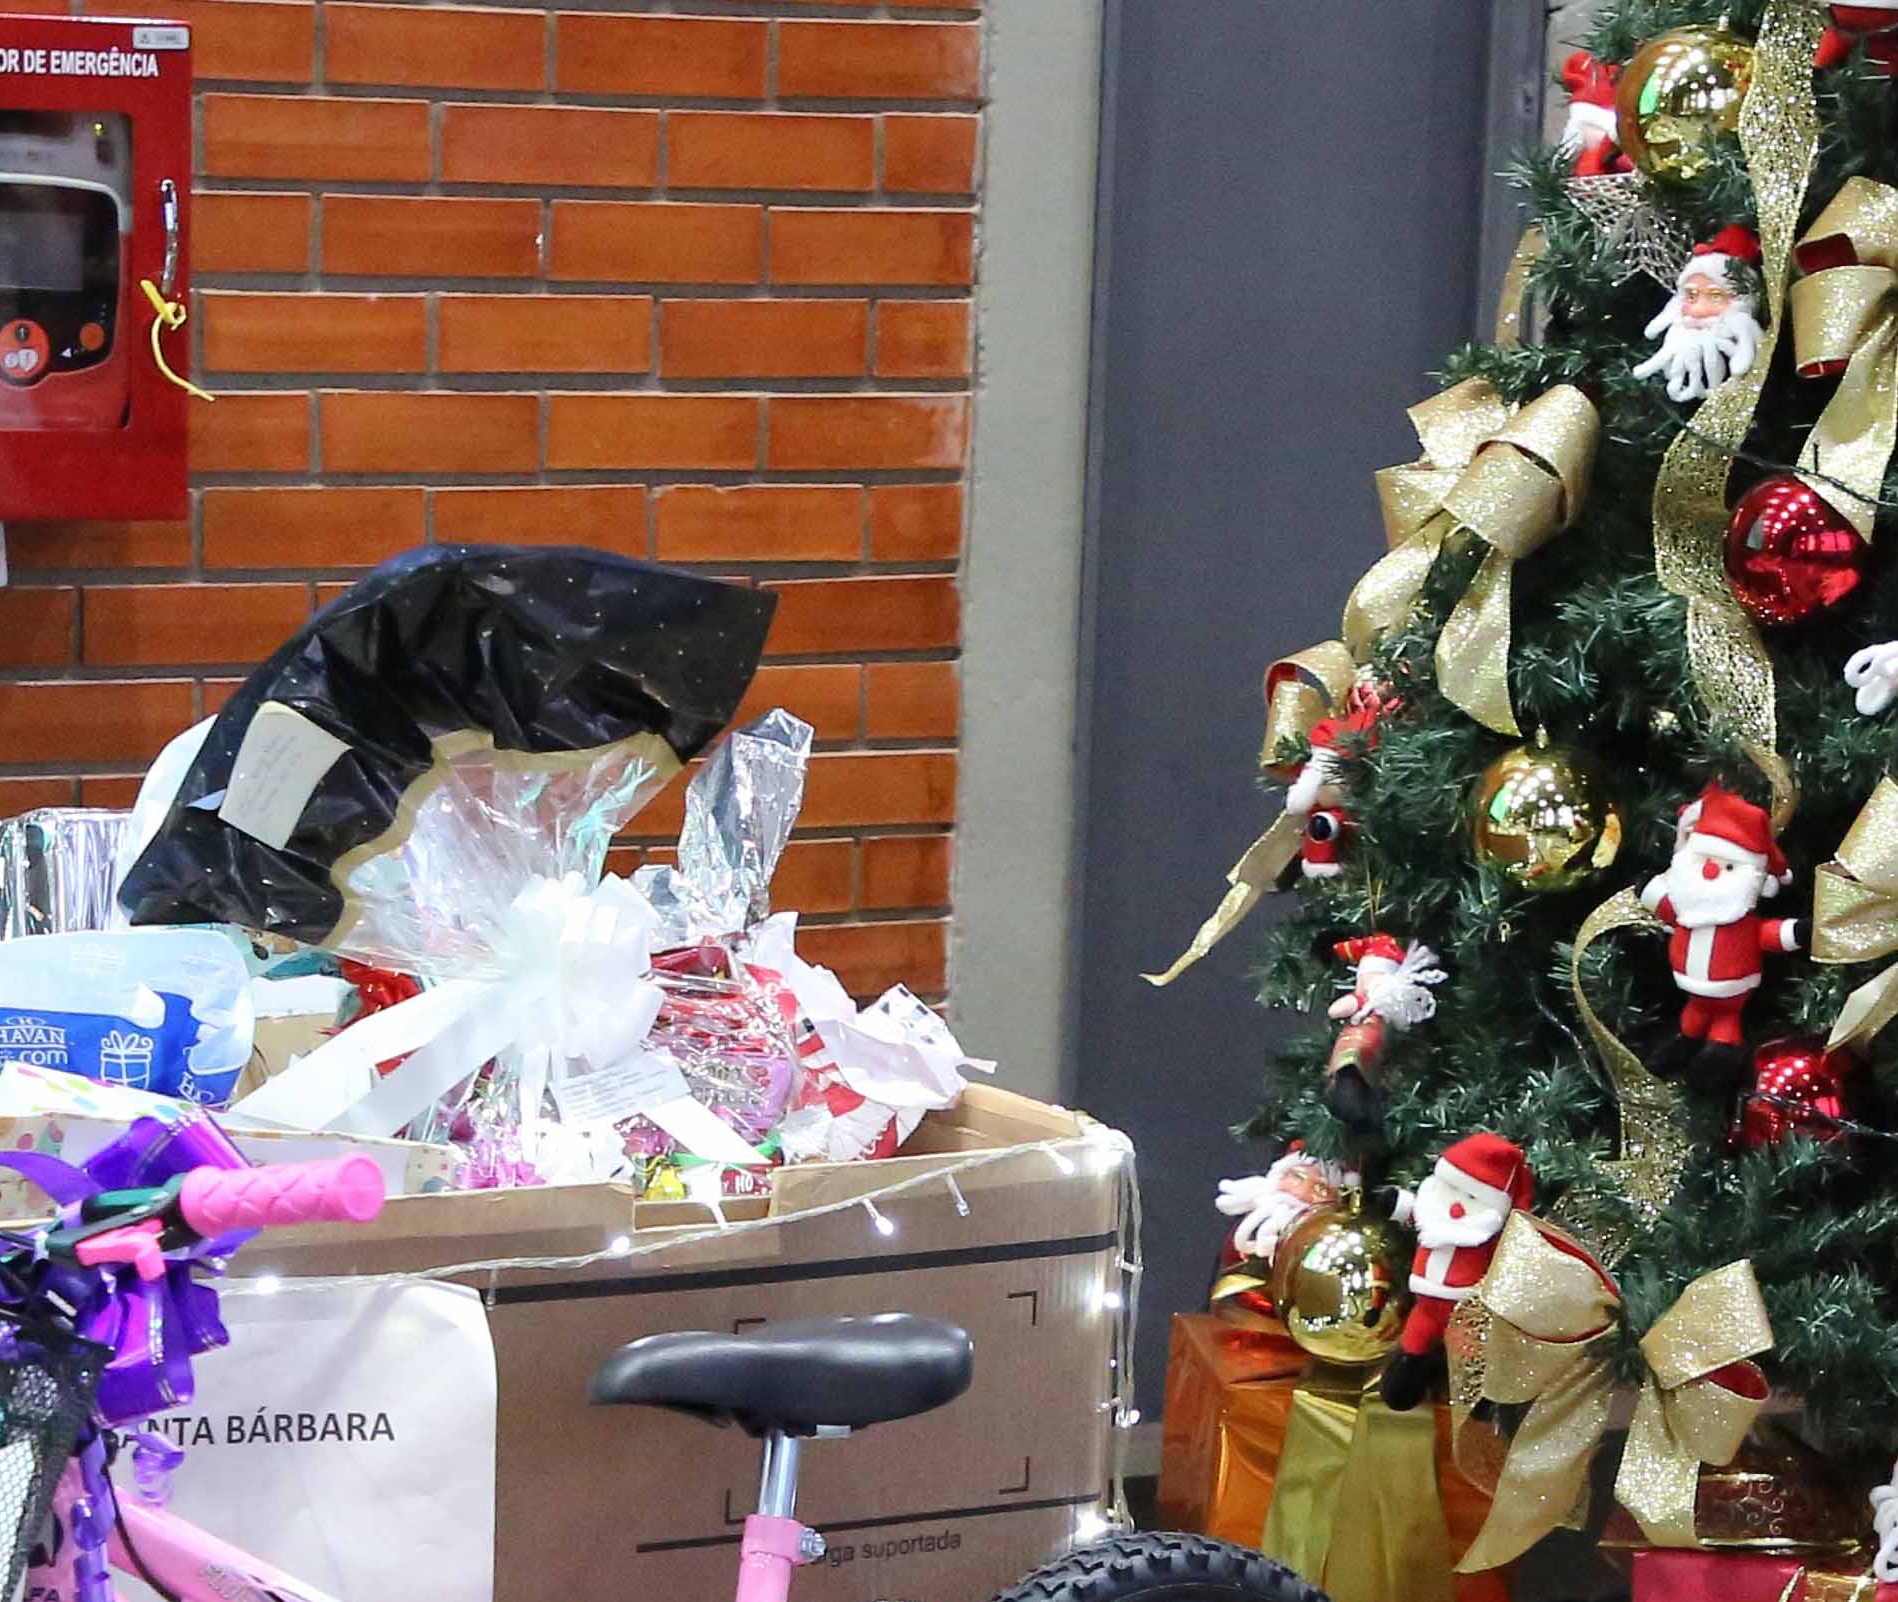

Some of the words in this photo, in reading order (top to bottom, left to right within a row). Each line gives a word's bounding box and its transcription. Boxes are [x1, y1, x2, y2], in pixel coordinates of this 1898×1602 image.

[23, 48, 47, 74] DE
[49, 45, 159, 77] EMERGÊNCIA
[225, 1405, 396, 1445] BÁRBARA
[860, 1529, 962, 1561] suportada
